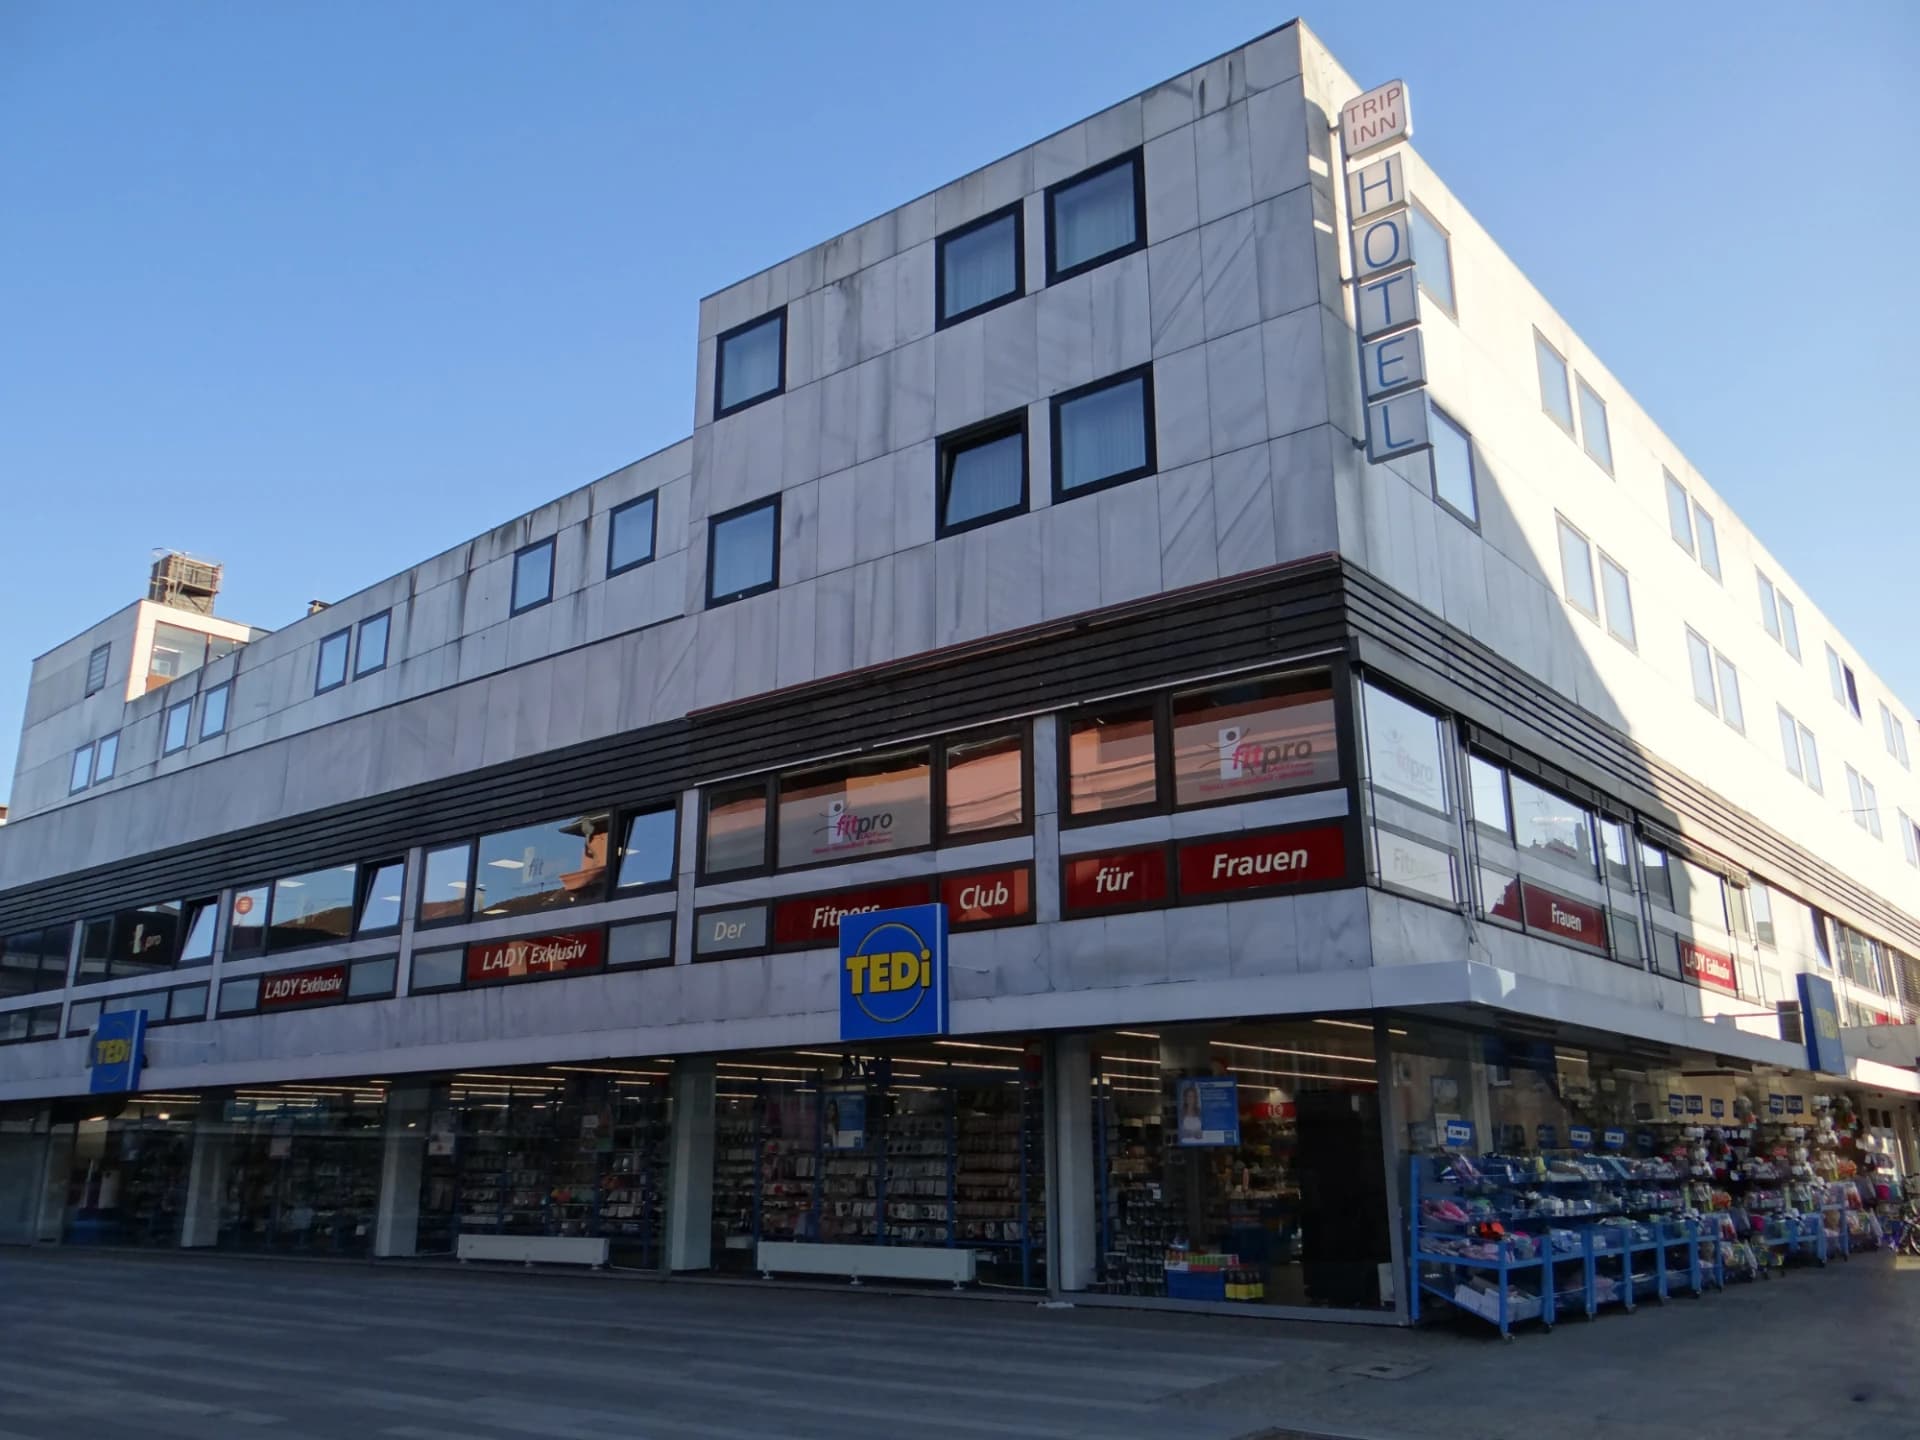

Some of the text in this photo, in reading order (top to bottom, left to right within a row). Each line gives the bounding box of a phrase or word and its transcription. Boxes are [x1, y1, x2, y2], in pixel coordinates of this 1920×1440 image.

[1346, 86, 1401, 124] TRIP
[1352, 114, 1397, 146] INN
[1358, 158, 1415, 452] HOTEL
[1231, 740, 1313, 774] fitpro
[836, 812, 894, 841] fitpro
[713, 848, 1308, 942] Der Fitn Club für Frauen
[1550, 902, 1582, 932] Frauen
[482, 940, 587, 972] LADY Exklusiv
[845, 948, 933, 996] TEDi
[1684, 945, 1706, 973] LADY
[264, 974, 344, 1000] LADY Exklusiv
